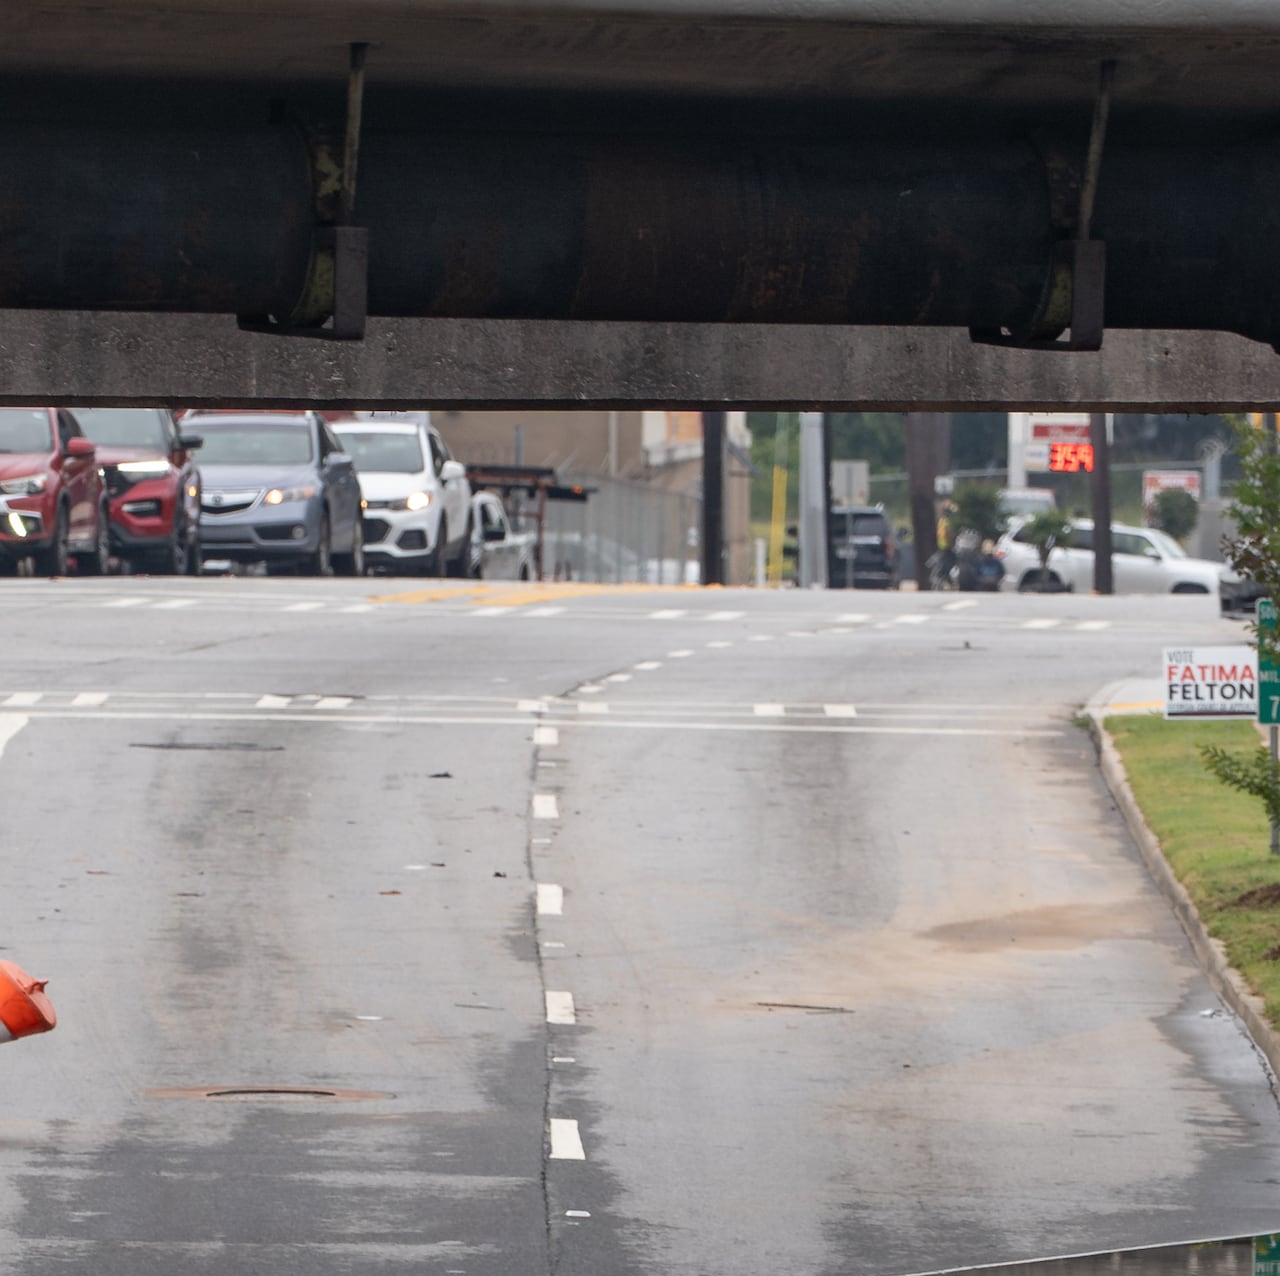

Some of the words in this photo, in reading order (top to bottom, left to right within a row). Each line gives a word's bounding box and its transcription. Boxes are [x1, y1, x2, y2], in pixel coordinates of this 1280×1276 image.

[1168, 650, 1194, 663] VOTE
[1168, 665, 1254, 682] FATIMA
[1169, 683, 1254, 700] FELTON
[1269, 696, 1280, 720] 7
